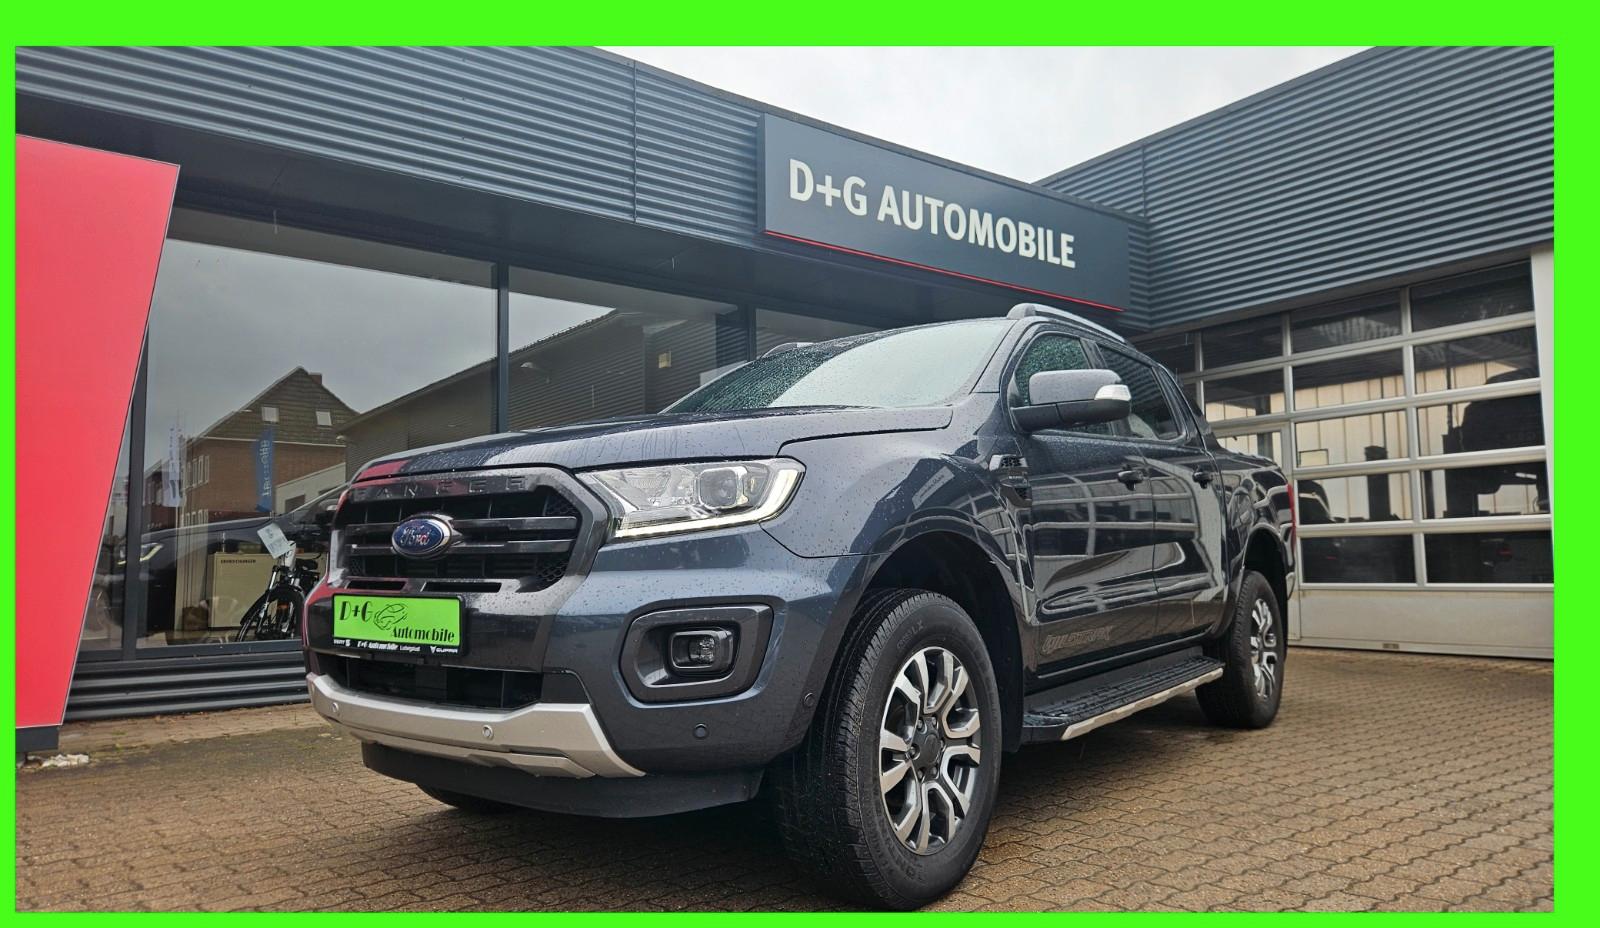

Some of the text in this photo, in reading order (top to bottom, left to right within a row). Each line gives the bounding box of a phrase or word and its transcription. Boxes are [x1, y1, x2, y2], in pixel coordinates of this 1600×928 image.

[789, 158, 1076, 269] D+G AUTOMOBILE
[400, 523, 431, 546] Ford
[339, 600, 373, 623] D+G
[391, 625, 455, 643] Automobile
